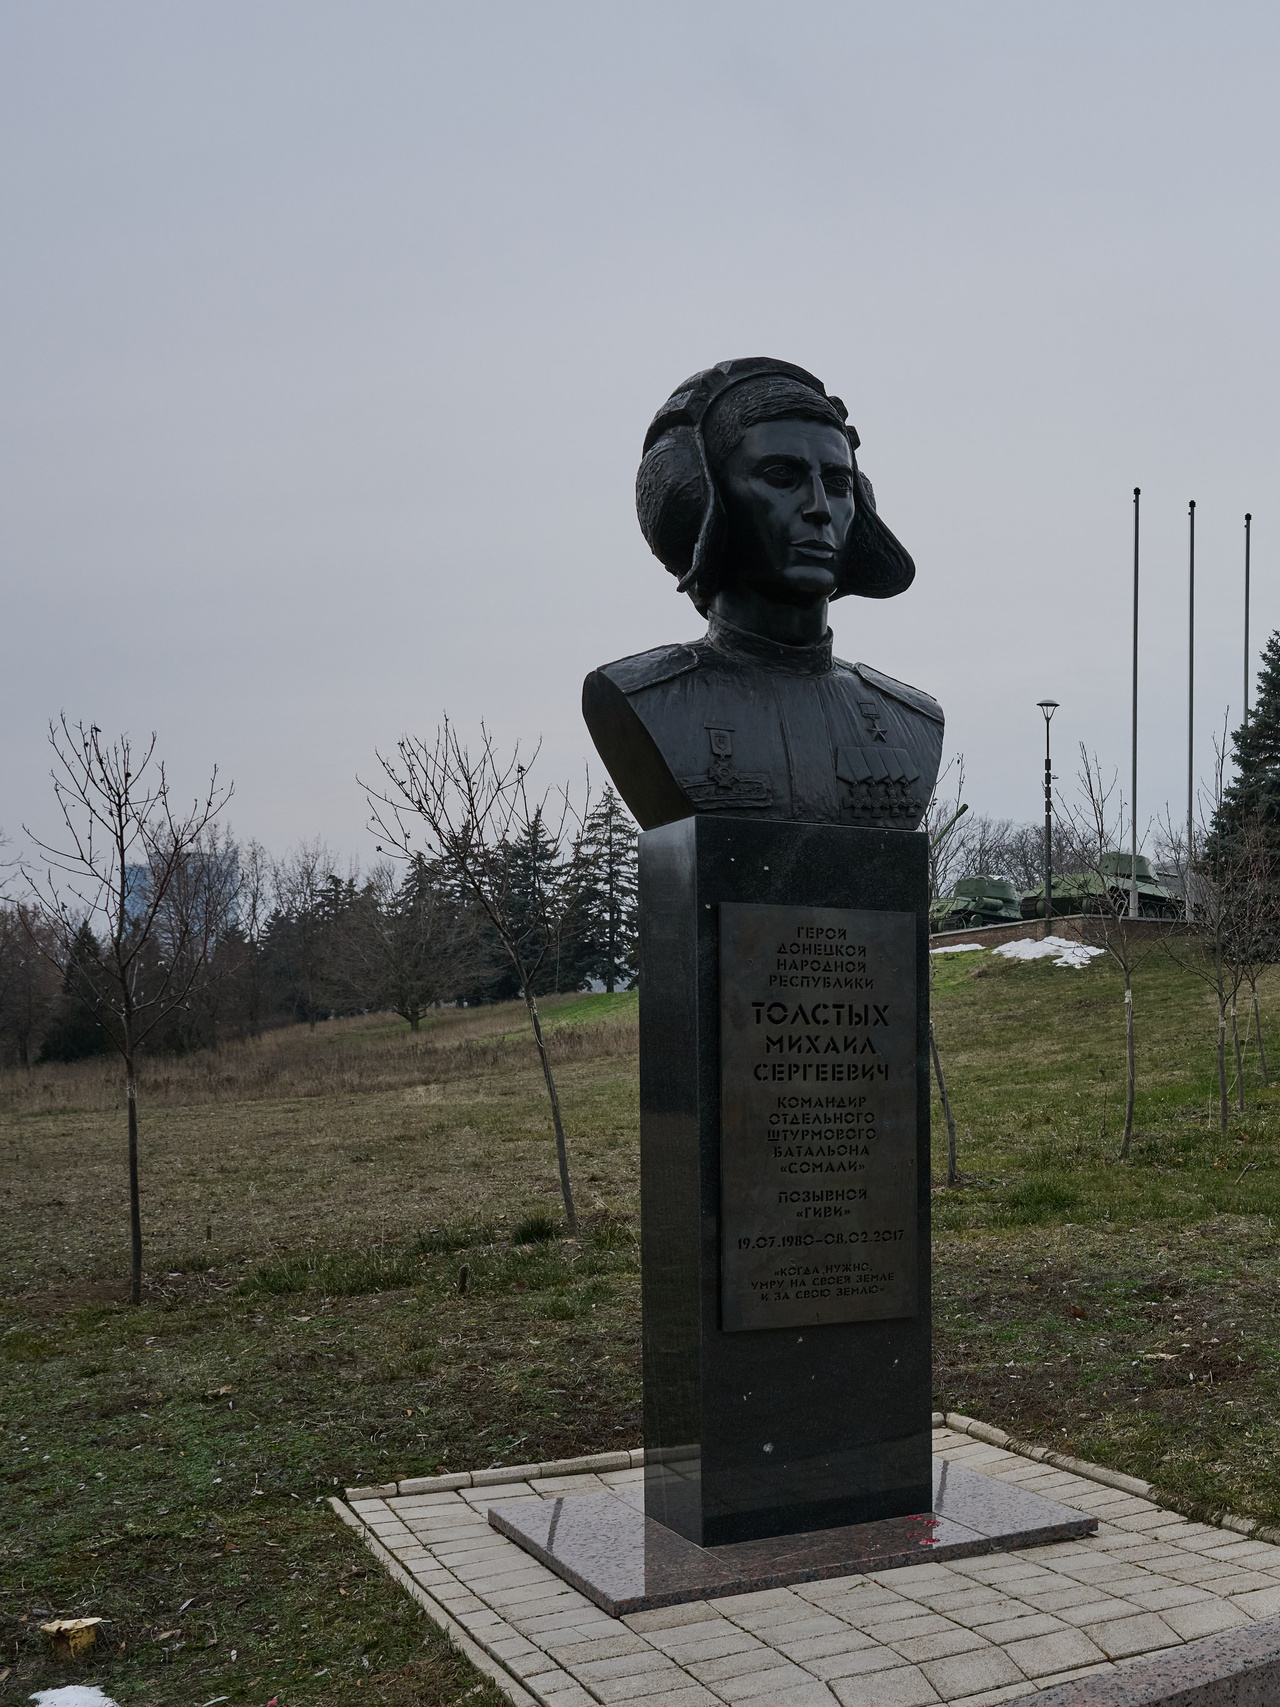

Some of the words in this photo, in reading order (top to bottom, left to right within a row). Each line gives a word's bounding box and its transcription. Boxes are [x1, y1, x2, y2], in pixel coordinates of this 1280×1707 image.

[797, 926, 847, 940] ГЕРОЙ
[777, 942, 866, 957] ДОНЕЦКОЙ
[777, 958, 866, 973] НАРОДНОЙ
[769, 974, 875, 990] РЕСПУБЛИКИ
[752, 1002, 890, 1027] ТОЛСТЫХ
[766, 1034, 877, 1055] МИХАИЛ
[753, 1063, 889, 1082] СЕРГЕЕВИЧ
[777, 1096, 867, 1109] КОМАНДИР
[769, 1112, 875, 1125] ОТДЕЛЬНОГО
[767, 1128, 877, 1141] ШТУРМОВОГО
[774, 1145, 870, 1158] БАТАЛЬОНА
[780, 1161, 865, 1174] «СОМАЛИ»
[778, 1188, 867, 1204] ПОЗЫВНОЙ
[796, 1206, 851, 1219] «ГИВИ»
[774, 1266, 819, 1276] «КОГДА
[751, 1279, 784, 1290] УМРУ
[790, 1278, 806, 1288] НА
[812, 1276, 851, 1286] СВОЕЙ
[856, 1273, 894, 1283] ЗЕМЛЕ
[761, 1294, 768, 1302] И
[774, 1292, 790, 1301] ЗА
[796, 1288, 830, 1299] СВОЮ
[837, 1285, 885, 1296] ЗЕМЛЮ»
